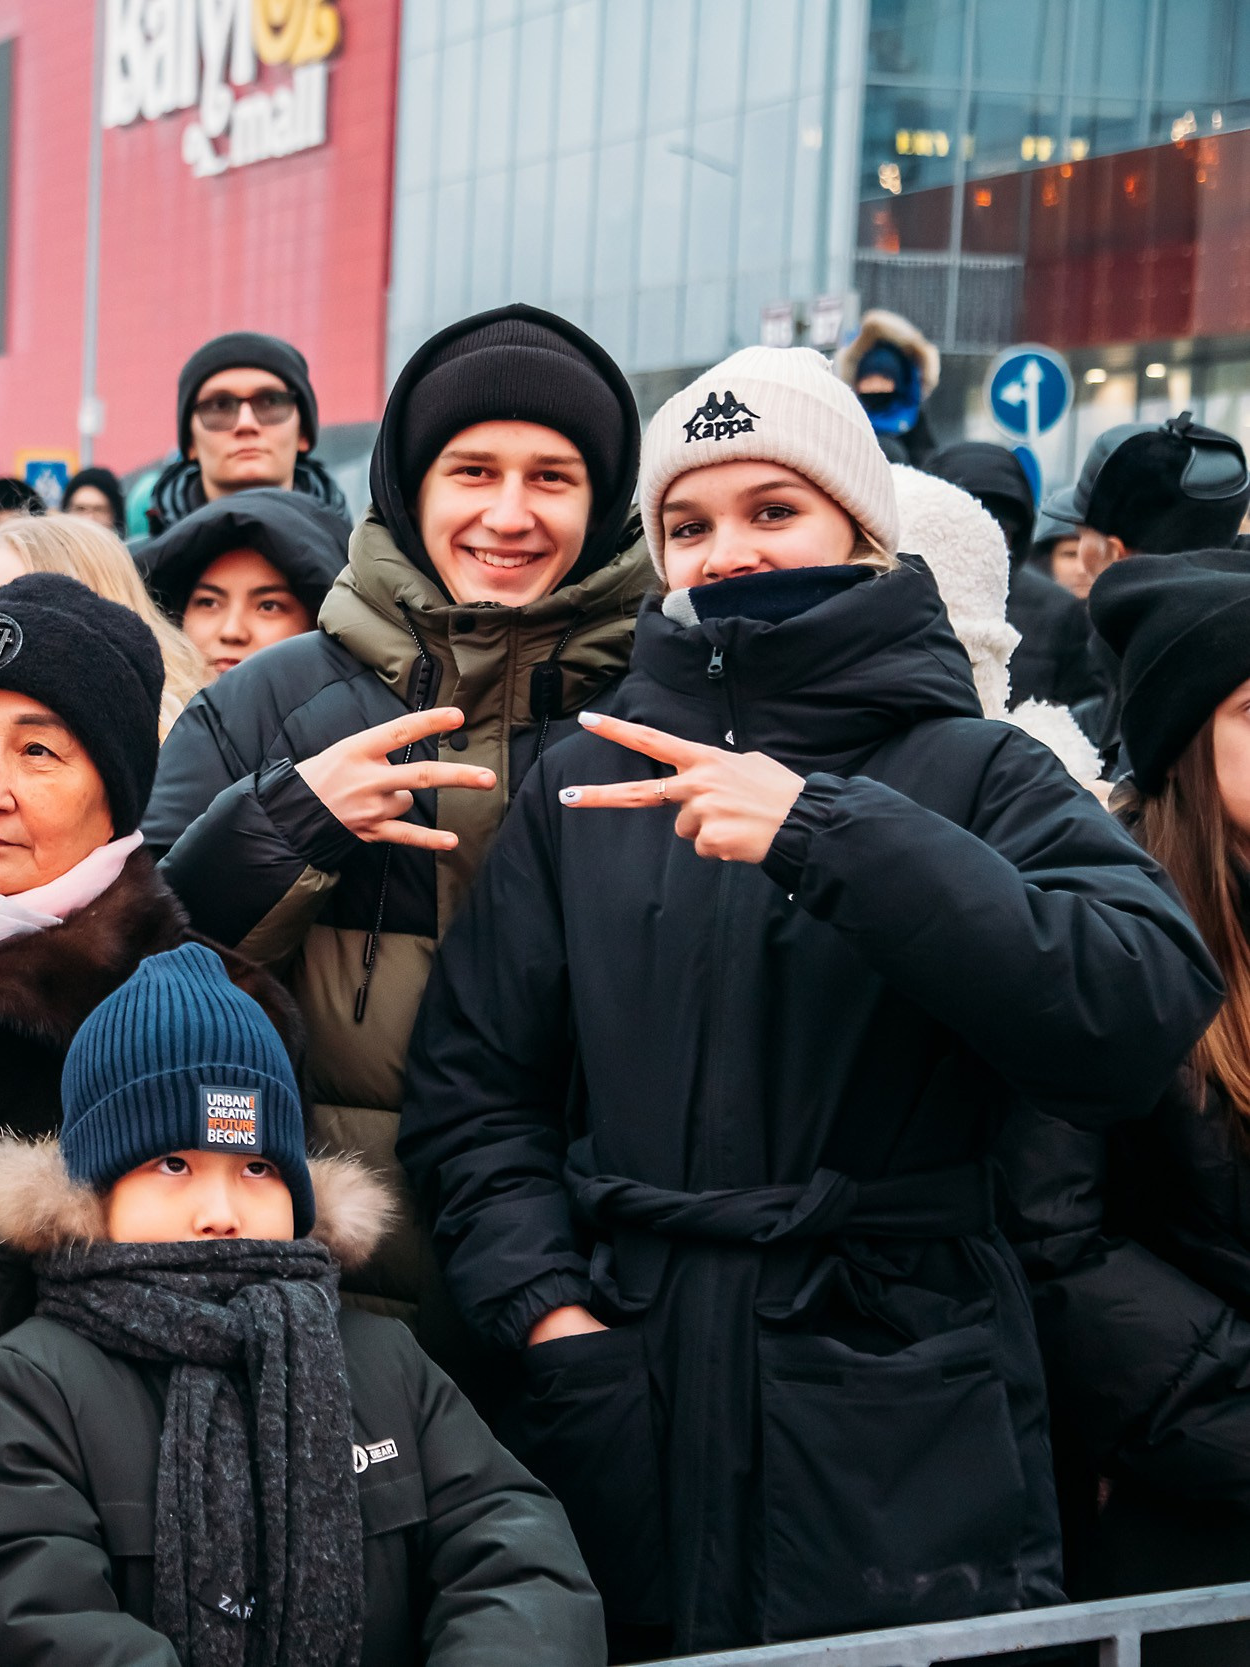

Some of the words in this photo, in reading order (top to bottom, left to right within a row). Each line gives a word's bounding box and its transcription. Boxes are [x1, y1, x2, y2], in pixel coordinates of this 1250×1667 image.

[229, 62, 328, 168] mall
[683, 417, 756, 443] Kappa
[207, 1093, 250, 1109] URBAN
[207, 1106, 256, 1121] CREATIVE
[214, 1119, 256, 1132] FUTURE
[207, 1129, 256, 1146] BEGINS
[217, 1591, 256, 1619] ZAR
